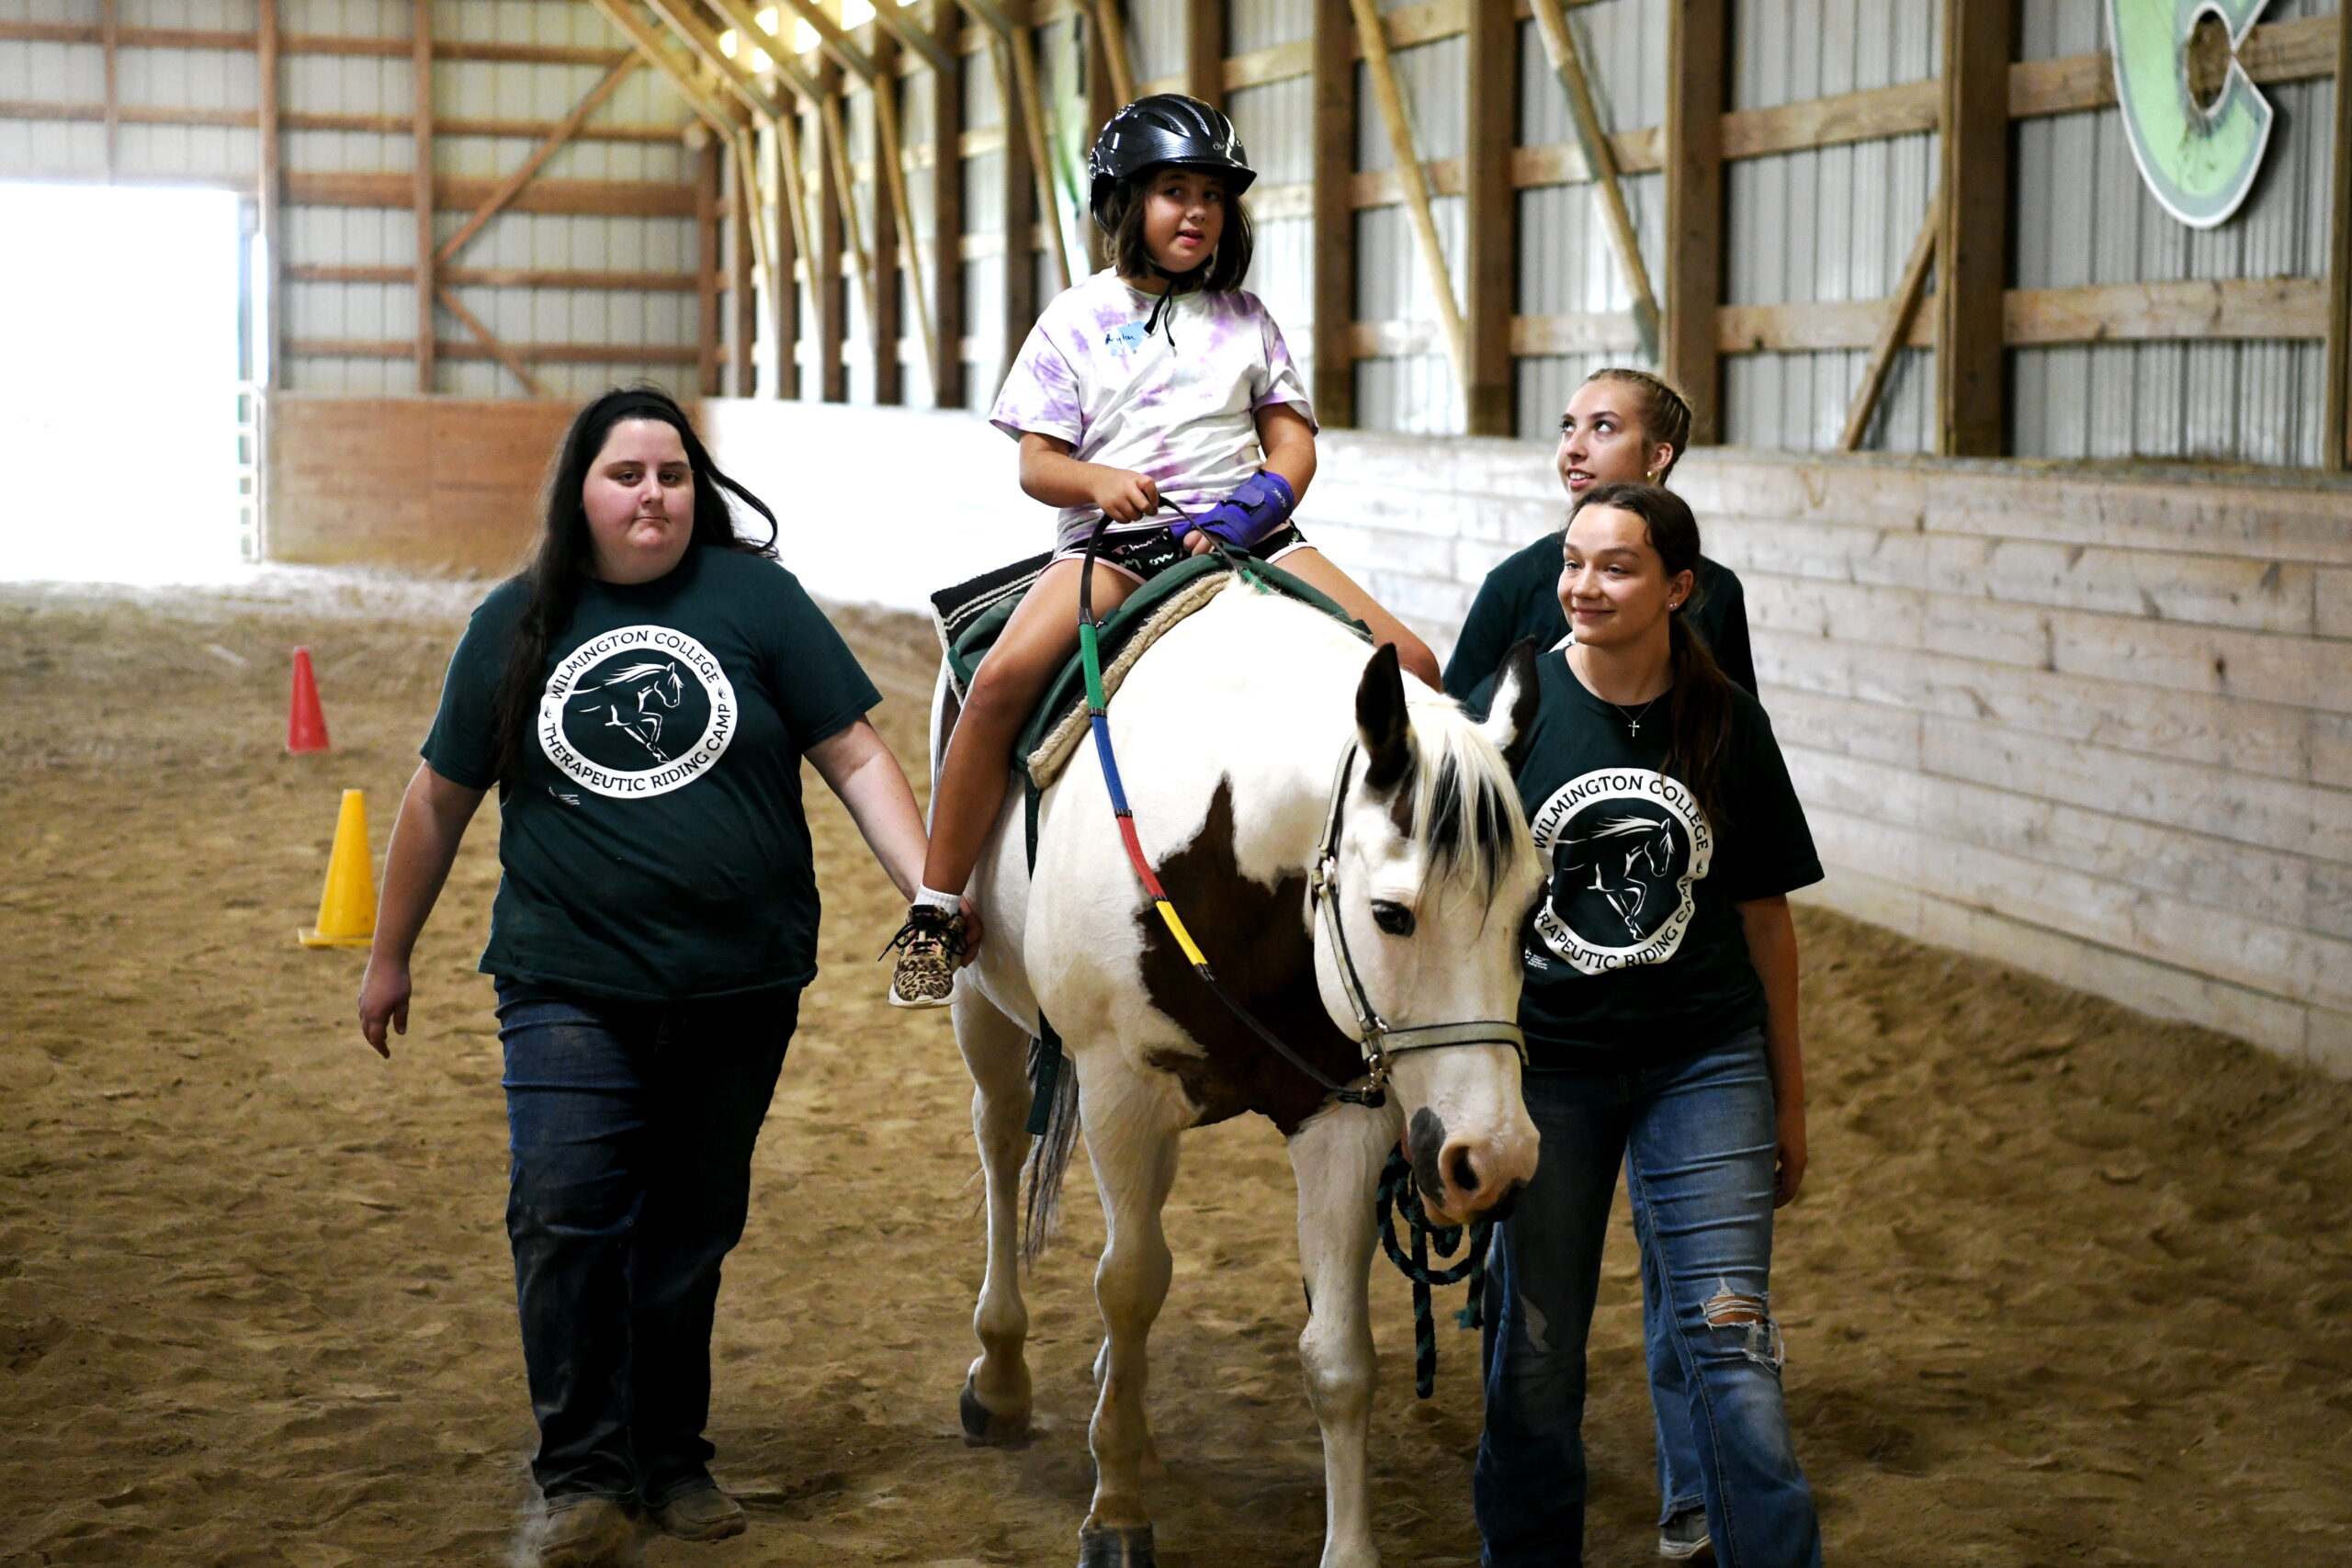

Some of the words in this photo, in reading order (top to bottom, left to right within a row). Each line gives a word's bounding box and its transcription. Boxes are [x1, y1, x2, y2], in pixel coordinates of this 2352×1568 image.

[550, 630, 649, 700] WILMINGTON
[654, 632, 719, 683] COLLEGE
[544, 722, 646, 792] THERAPEUTIC
[650, 750, 710, 789] RIDING
[706, 704, 731, 751] CAMP
[1533, 775, 1644, 850] WILMINGTON
[1649, 780, 1709, 852] COLLEGE
[1537, 908, 1617, 970] RAPEUTIC
[1624, 926, 1679, 967] RIDING
